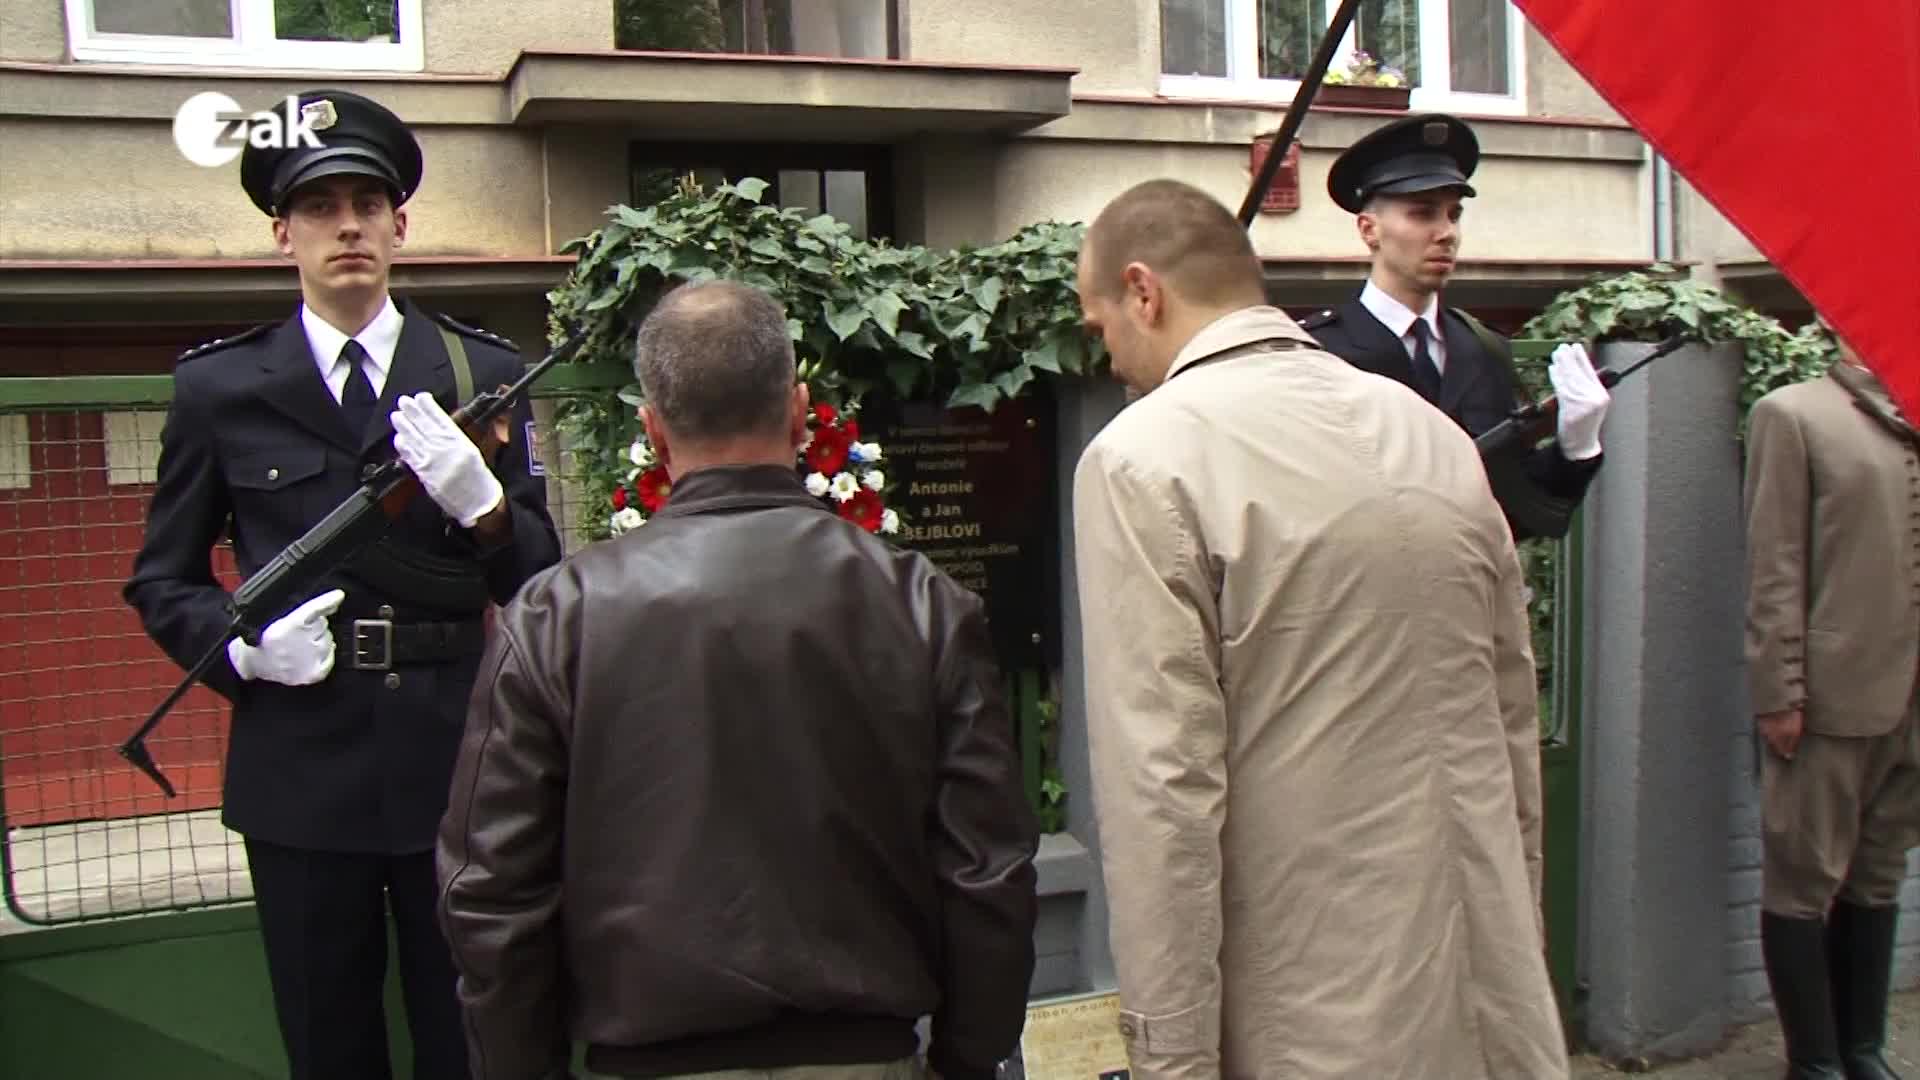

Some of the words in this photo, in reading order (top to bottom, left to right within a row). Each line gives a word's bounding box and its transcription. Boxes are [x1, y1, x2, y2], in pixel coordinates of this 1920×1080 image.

[908, 480, 975, 497] Antonie
[920, 505, 932, 518] a
[935, 503, 962, 517] Jan
